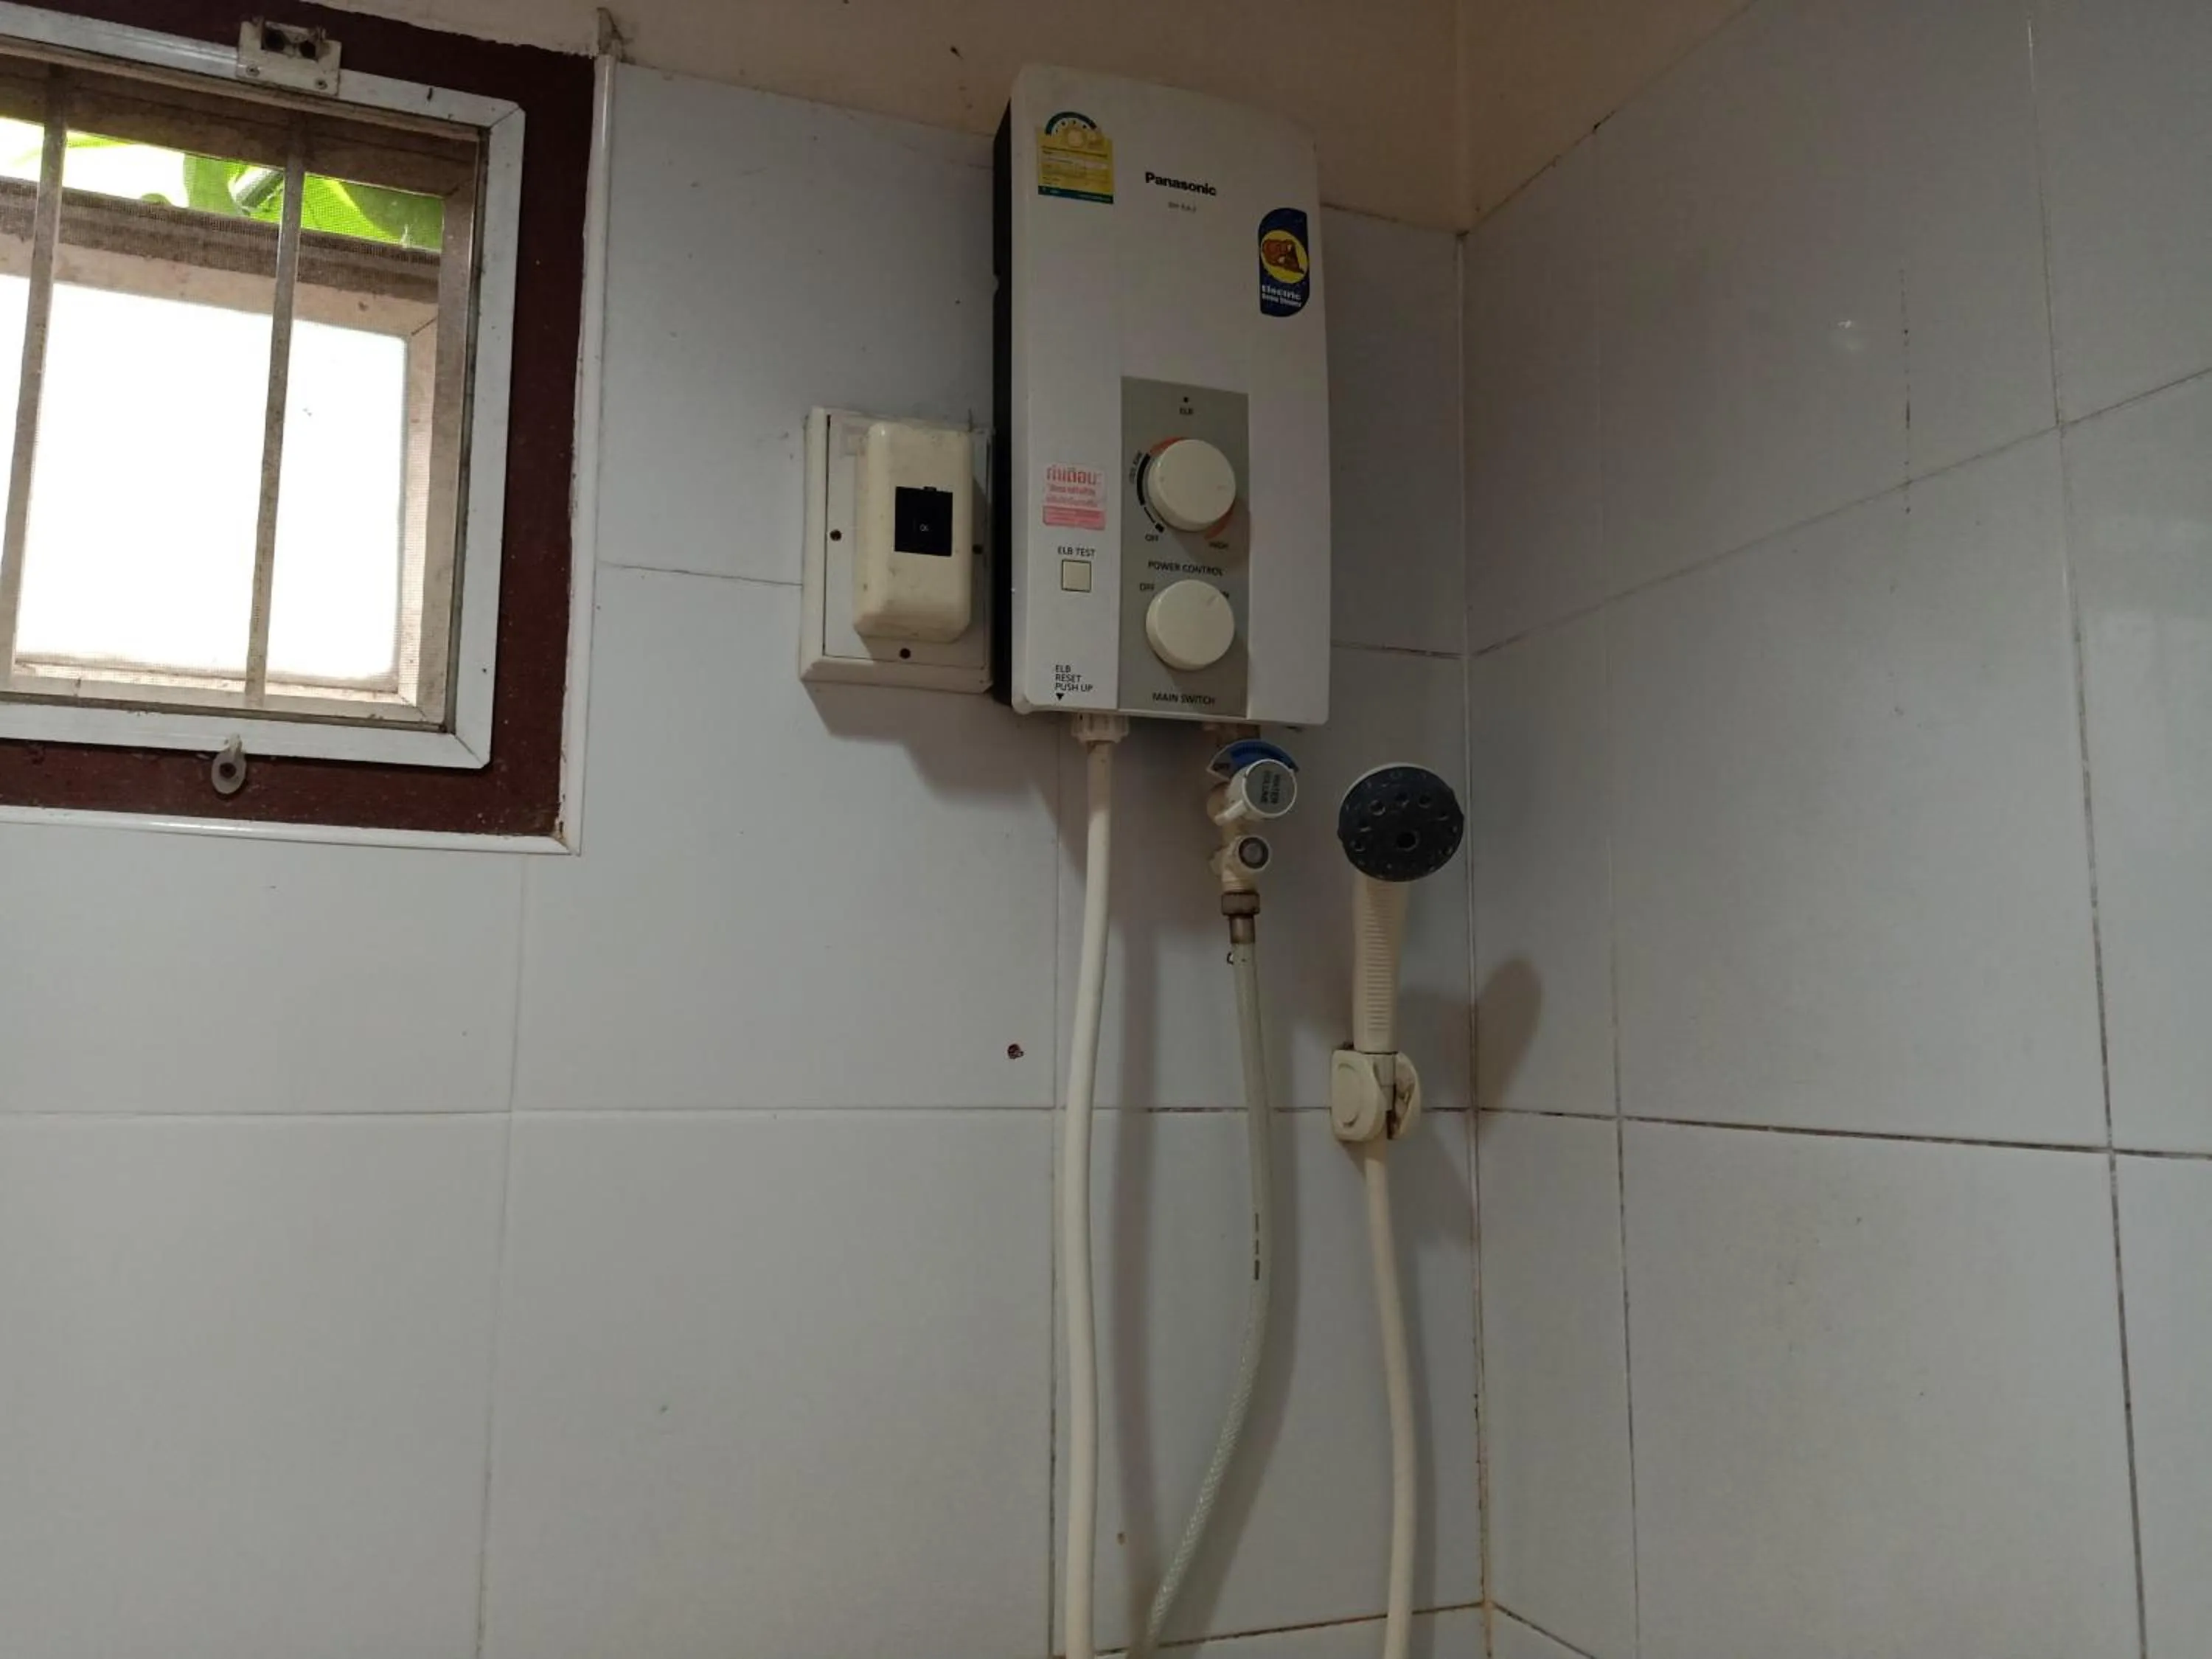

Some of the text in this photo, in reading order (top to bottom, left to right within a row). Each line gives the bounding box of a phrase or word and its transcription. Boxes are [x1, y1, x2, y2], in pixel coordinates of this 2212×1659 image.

[1145, 171, 1217, 196] Panasonic
[1179, 407, 1194, 415] ELB
[1144, 534, 1159, 542] OFF
[1057, 546, 1096, 557] ELB TEST
[1147, 560, 1224, 577] POWER CONTROL
[1139, 582, 1155, 591] OFF
[1055, 664, 1071, 673] ELB
[1055, 673, 1082, 683] RESET
[1055, 682, 1093, 692] PUSH UP
[1152, 692, 1217, 706] MAIN SWITCH
